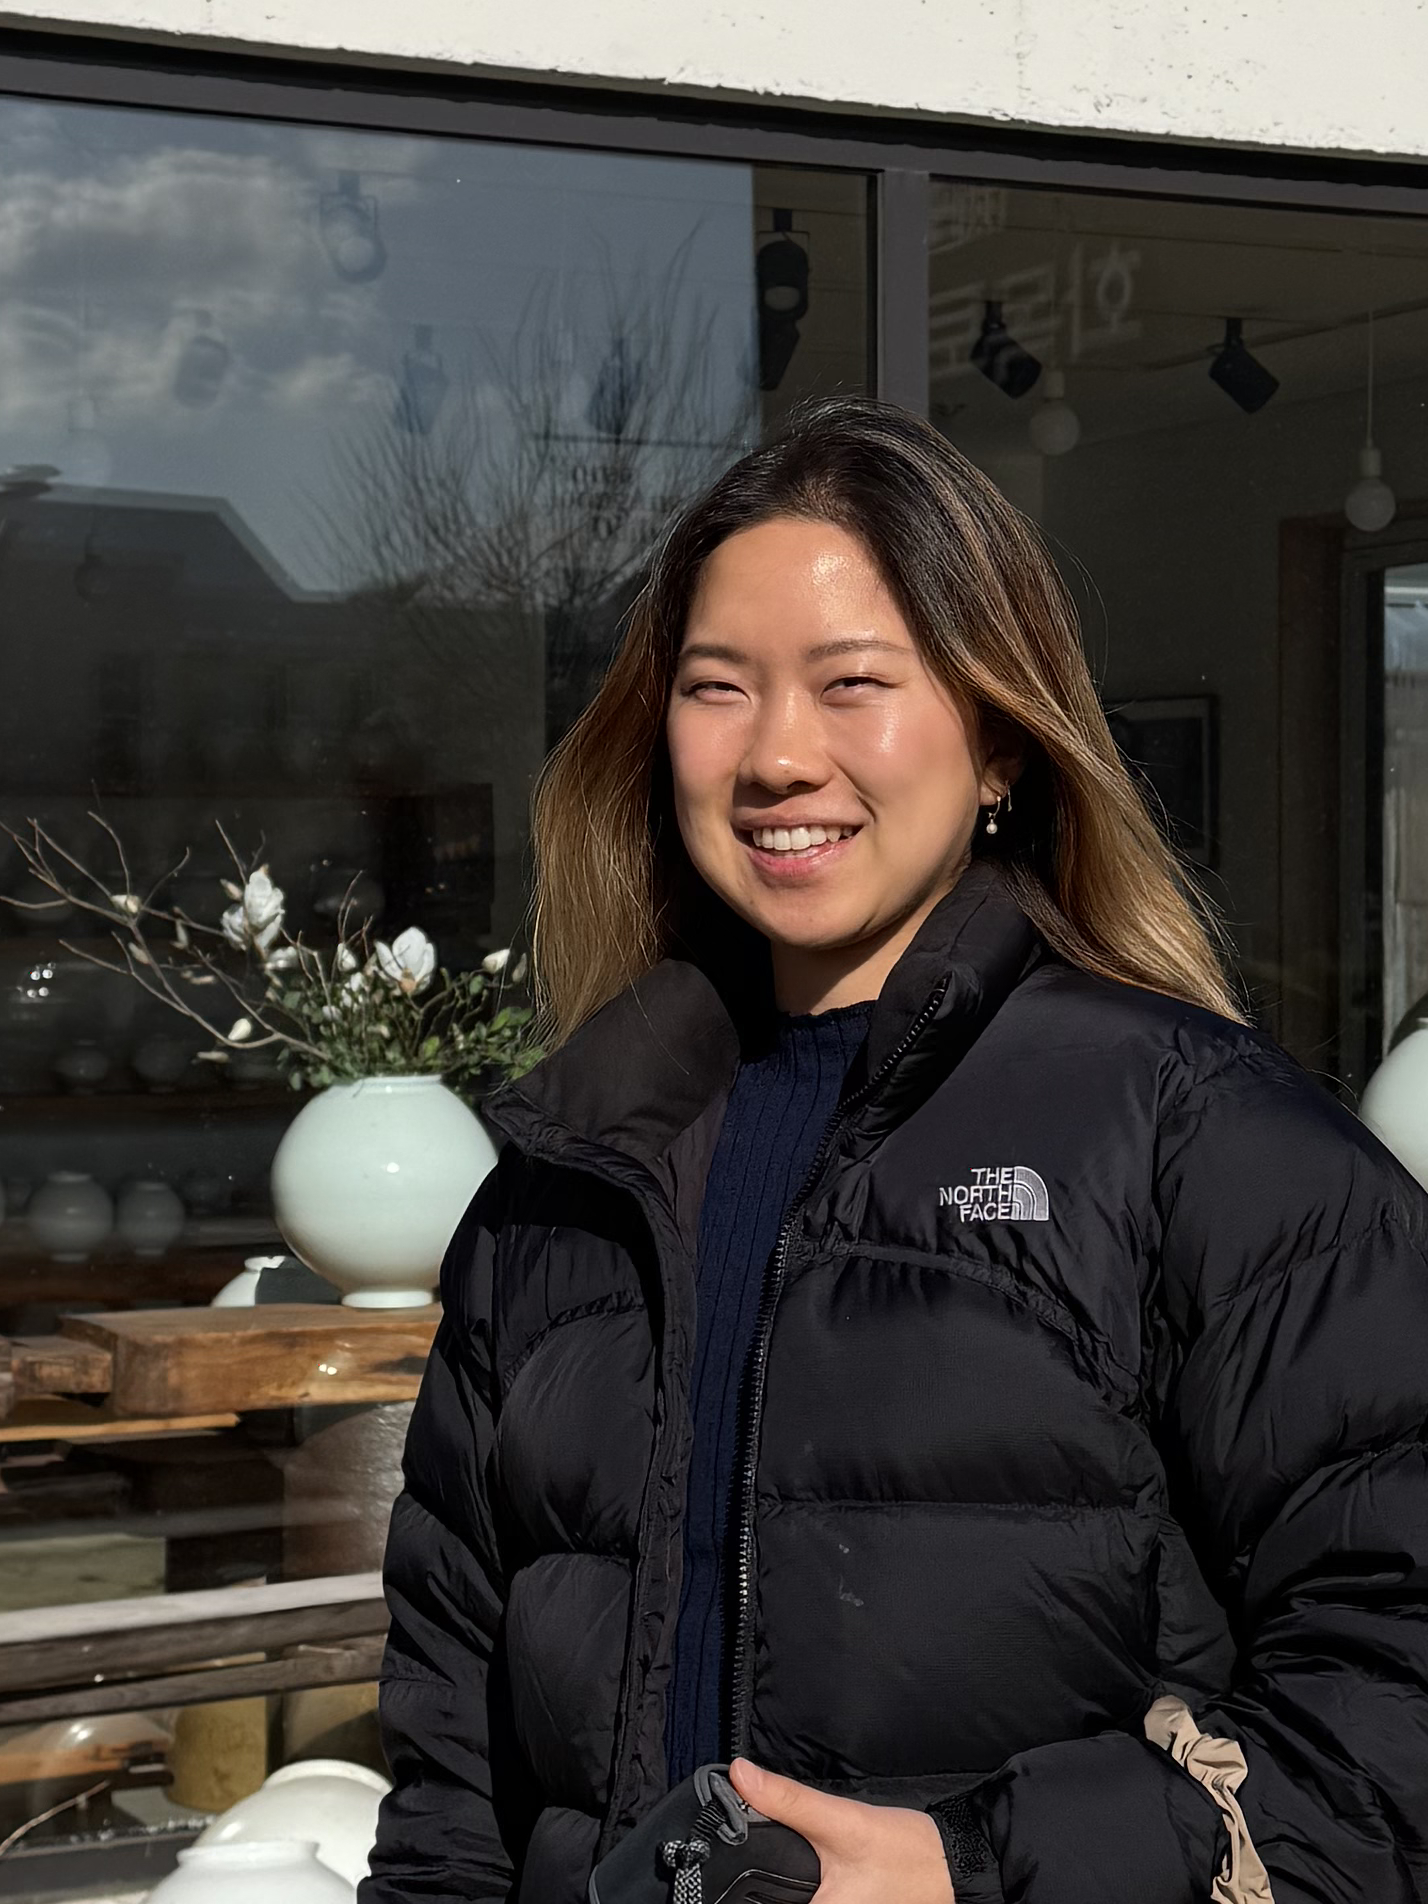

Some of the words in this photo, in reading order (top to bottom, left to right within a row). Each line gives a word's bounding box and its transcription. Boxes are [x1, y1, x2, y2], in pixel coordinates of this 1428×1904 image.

[971, 1167, 1014, 1184] THE
[939, 1184, 1012, 1206] NORTH
[960, 1202, 1012, 1223] FACE
